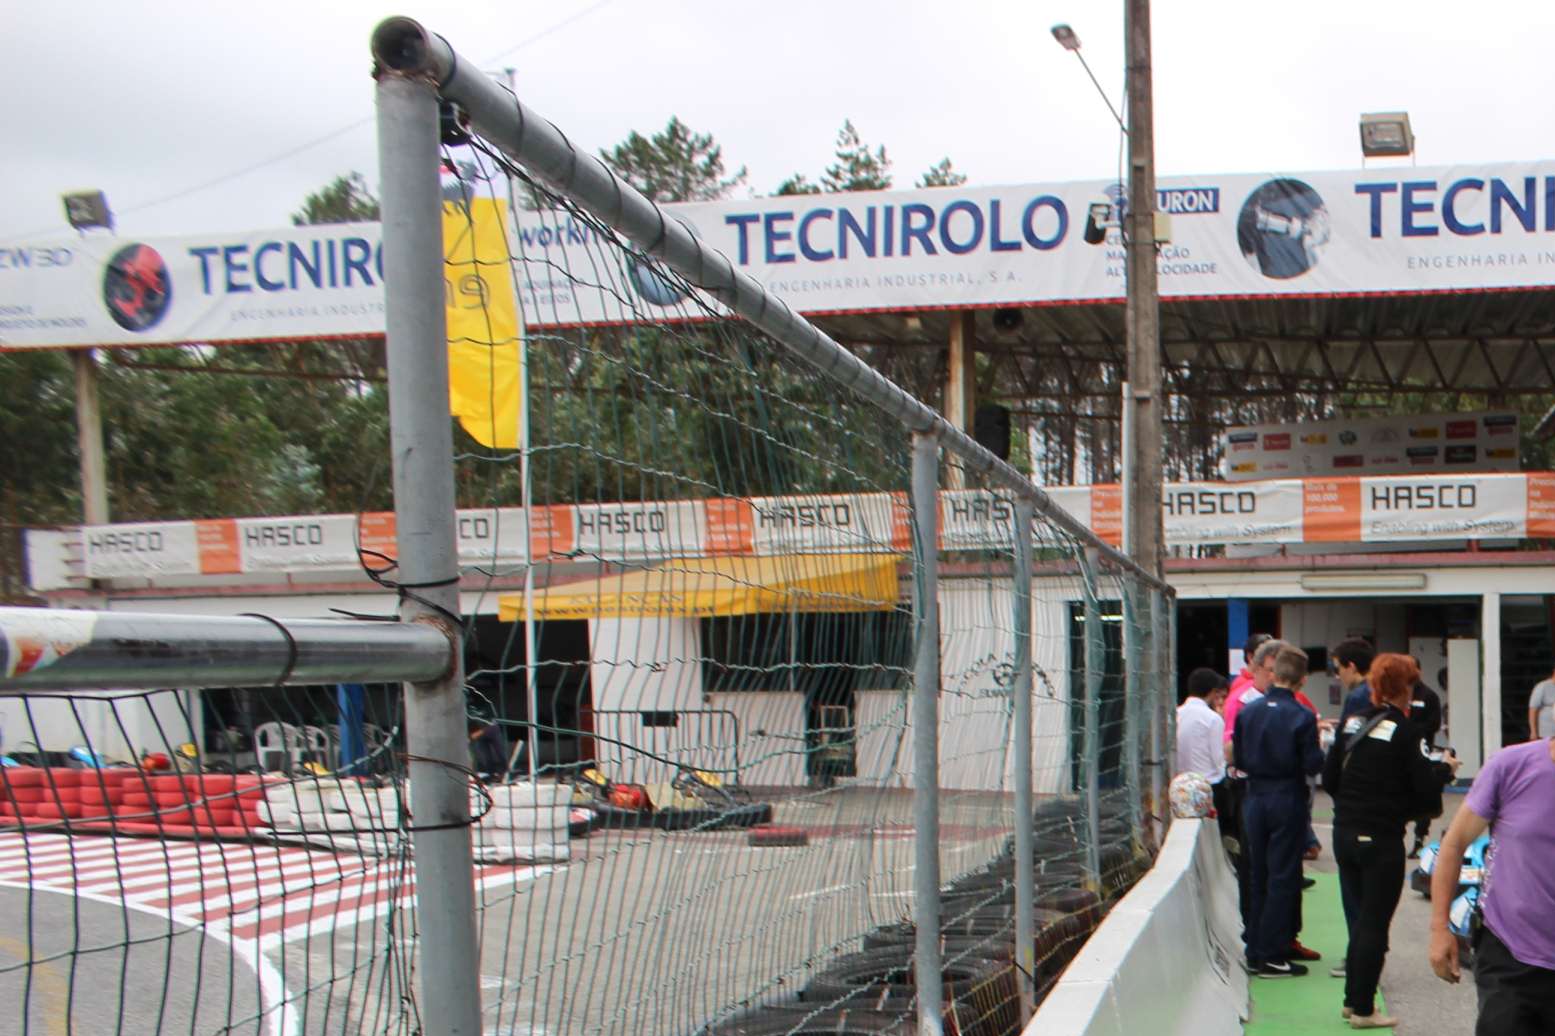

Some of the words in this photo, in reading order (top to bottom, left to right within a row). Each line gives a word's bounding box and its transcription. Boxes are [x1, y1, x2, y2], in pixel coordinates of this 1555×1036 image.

[1156, 190, 1215, 213] URON
[724, 195, 1070, 266] TECNIROLO
[188, 236, 385, 296] TECNIR
[1406, 252, 1529, 270] ENGENHARIA
[769, 277, 870, 294] ENGENHARIA
[1371, 484, 1477, 510] HASCO
[579, 510, 666, 536] HASCO
[759, 503, 851, 529] HASCO
[89, 531, 164, 555] HASCO
[245, 524, 323, 548] HASCO
